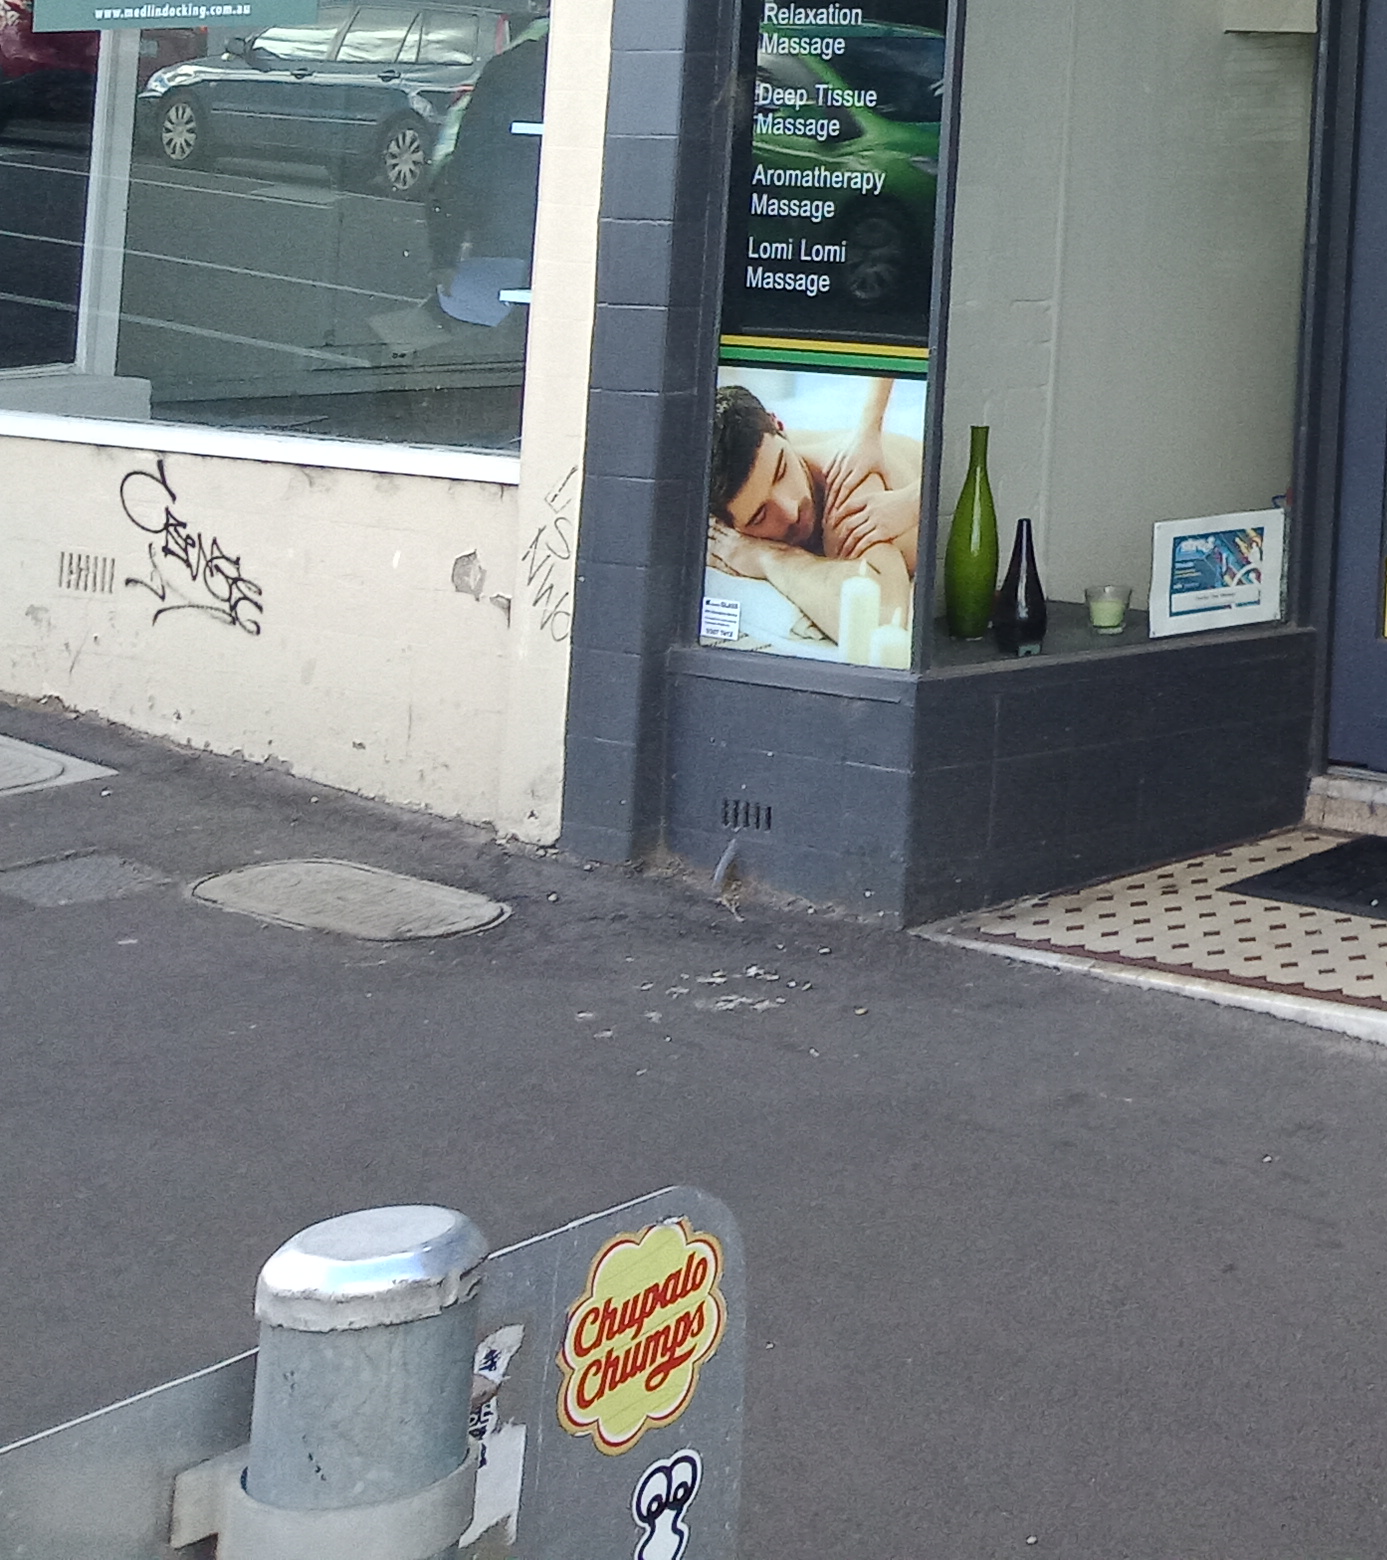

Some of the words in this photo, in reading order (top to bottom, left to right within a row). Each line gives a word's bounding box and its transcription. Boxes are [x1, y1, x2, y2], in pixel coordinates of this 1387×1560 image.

[95, 3, 251, 19] www.medlindocking.com.au
[763, 3, 863, 26] Relaxation
[761, 32, 845, 59] Massage
[757, 83, 808, 110] Deep
[815, 84, 877, 107] Tissue
[756, 113, 840, 141] Massage
[752, 164, 886, 195] Aromatherapy
[751, 193, 835, 222] Massage
[748, 236, 793, 261] Lomi
[800, 239, 846, 263] Lomi
[746, 266, 831, 297] Massage
[573, 1251, 707, 1358] Chupalo
[576, 1300, 706, 1410] Chumps
